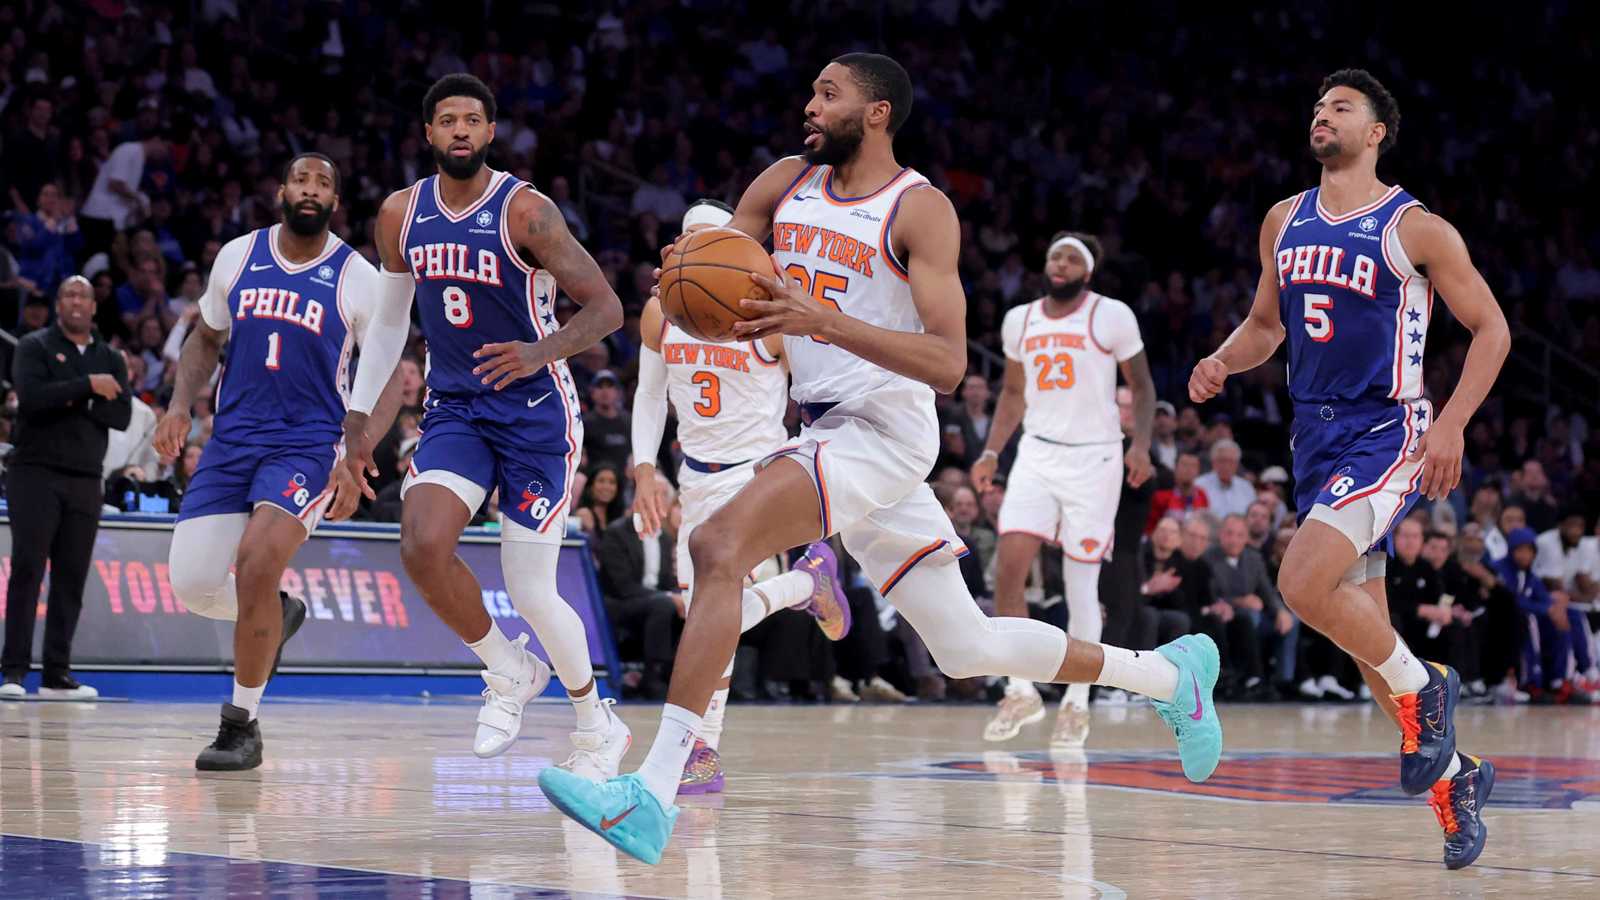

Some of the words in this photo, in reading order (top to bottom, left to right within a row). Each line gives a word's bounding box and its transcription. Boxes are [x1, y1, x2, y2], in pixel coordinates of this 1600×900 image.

[408, 242, 503, 288] PHILA
[774, 222, 818, 255] NEW
[817, 228, 877, 279] YORK
[1277, 245, 1378, 300] PHILA
[237, 287, 324, 336] PHILA
[443, 285, 474, 328] 8
[1303, 293, 1334, 342] 5
[265, 331, 281, 370] 1
[664, 343, 700, 365] NEW
[703, 343, 751, 374] YORK
[1033, 352, 1076, 391] 23
[691, 370, 721, 418] 3
[281, 480, 309, 507] 76
[518, 489, 551, 520] 76
[95, 559, 188, 614] YOR
[280, 566, 409, 629] REVER
